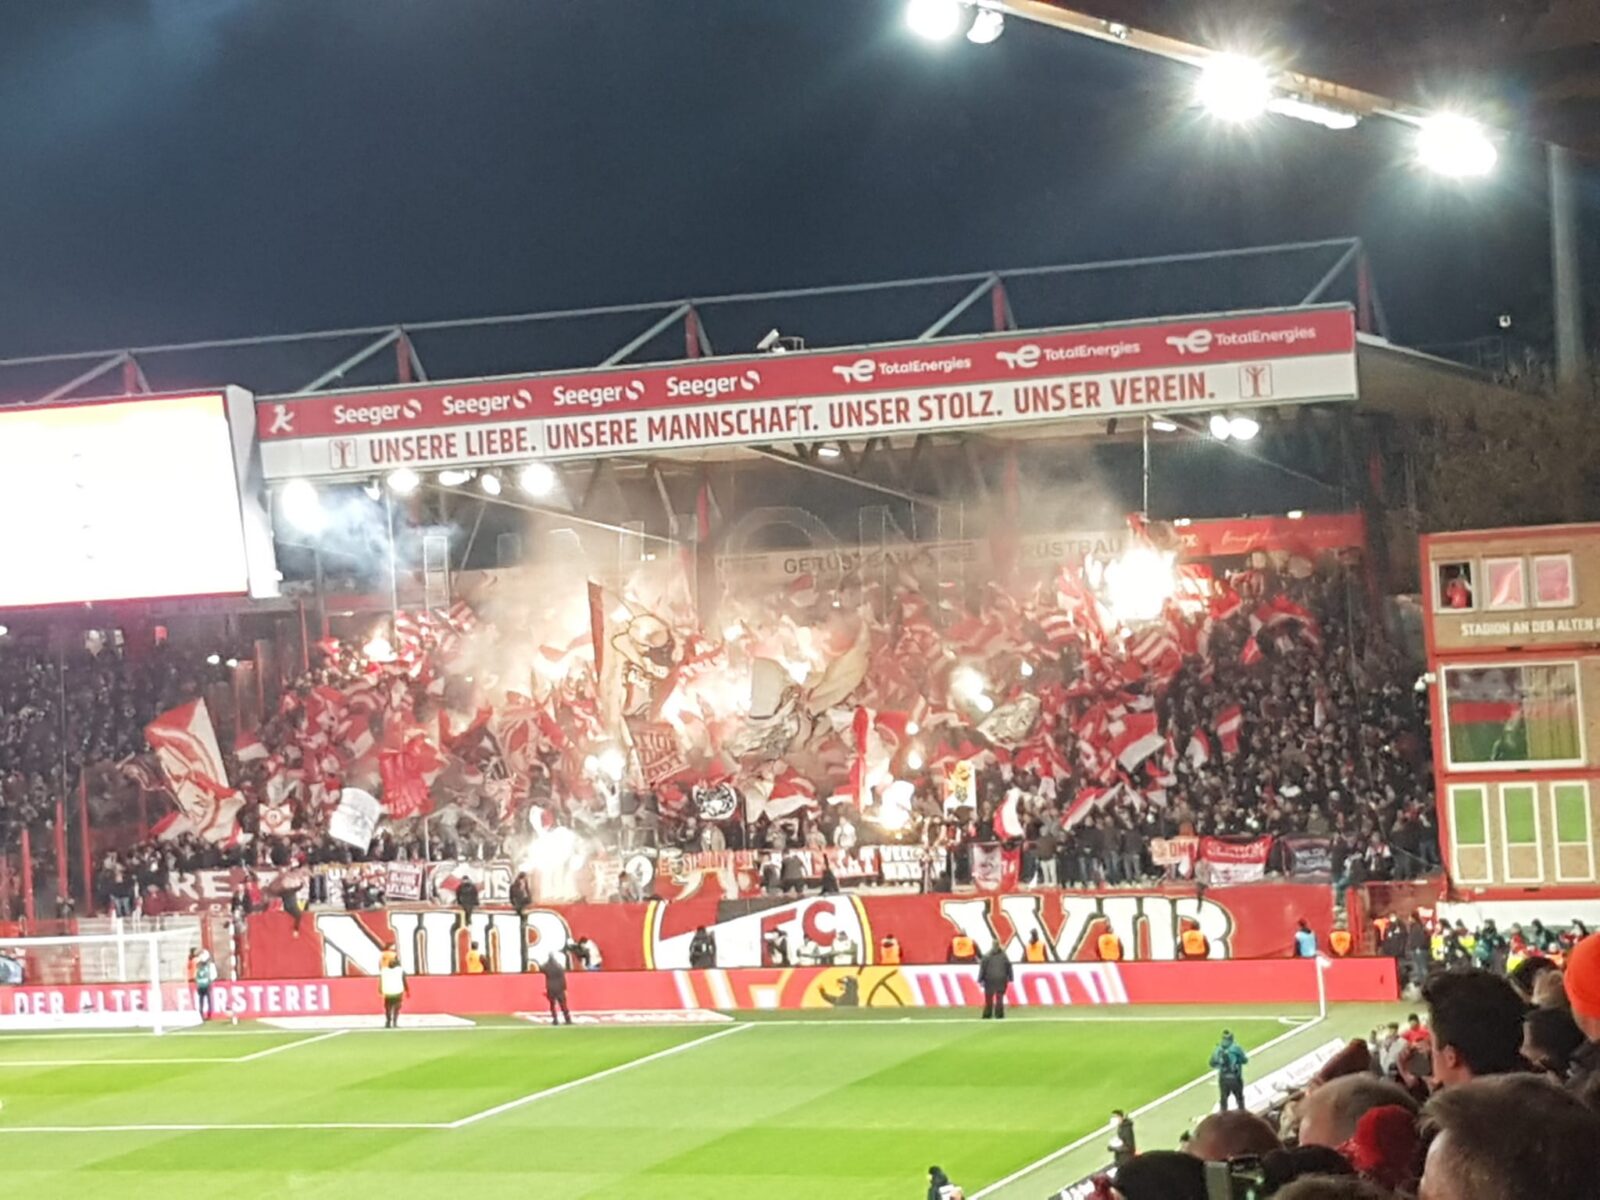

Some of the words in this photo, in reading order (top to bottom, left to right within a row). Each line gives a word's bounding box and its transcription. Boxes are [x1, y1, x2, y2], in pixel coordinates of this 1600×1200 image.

[1215, 326, 1317, 346] TotalEnergies
[1044, 341, 1142, 360] TotalEnergies
[878, 357, 972, 376] TotalEnergies
[553, 385, 624, 407] Seeger
[666, 375, 739, 398] Seeger
[333, 403, 401, 425] Seeger
[442, 394, 511, 416] Seeger
[369, 432, 458, 465] UNSERE
[465, 426, 537, 458] LIEBE.
[547, 418, 638, 450] UNSERE
[648, 405, 819, 443] MANNSCHAFT.
[829, 399, 911, 429] UNSER
[918, 390, 1004, 422] STOLZ.
[1014, 381, 1101, 414] UNSER
[1110, 372, 1216, 406] VEREIN.
[1513, 621, 1530, 634] AN
[1532, 619, 1555, 633] DER
[1557, 617, 1595, 631] ALTEN
[14, 991, 64, 1013] DER
